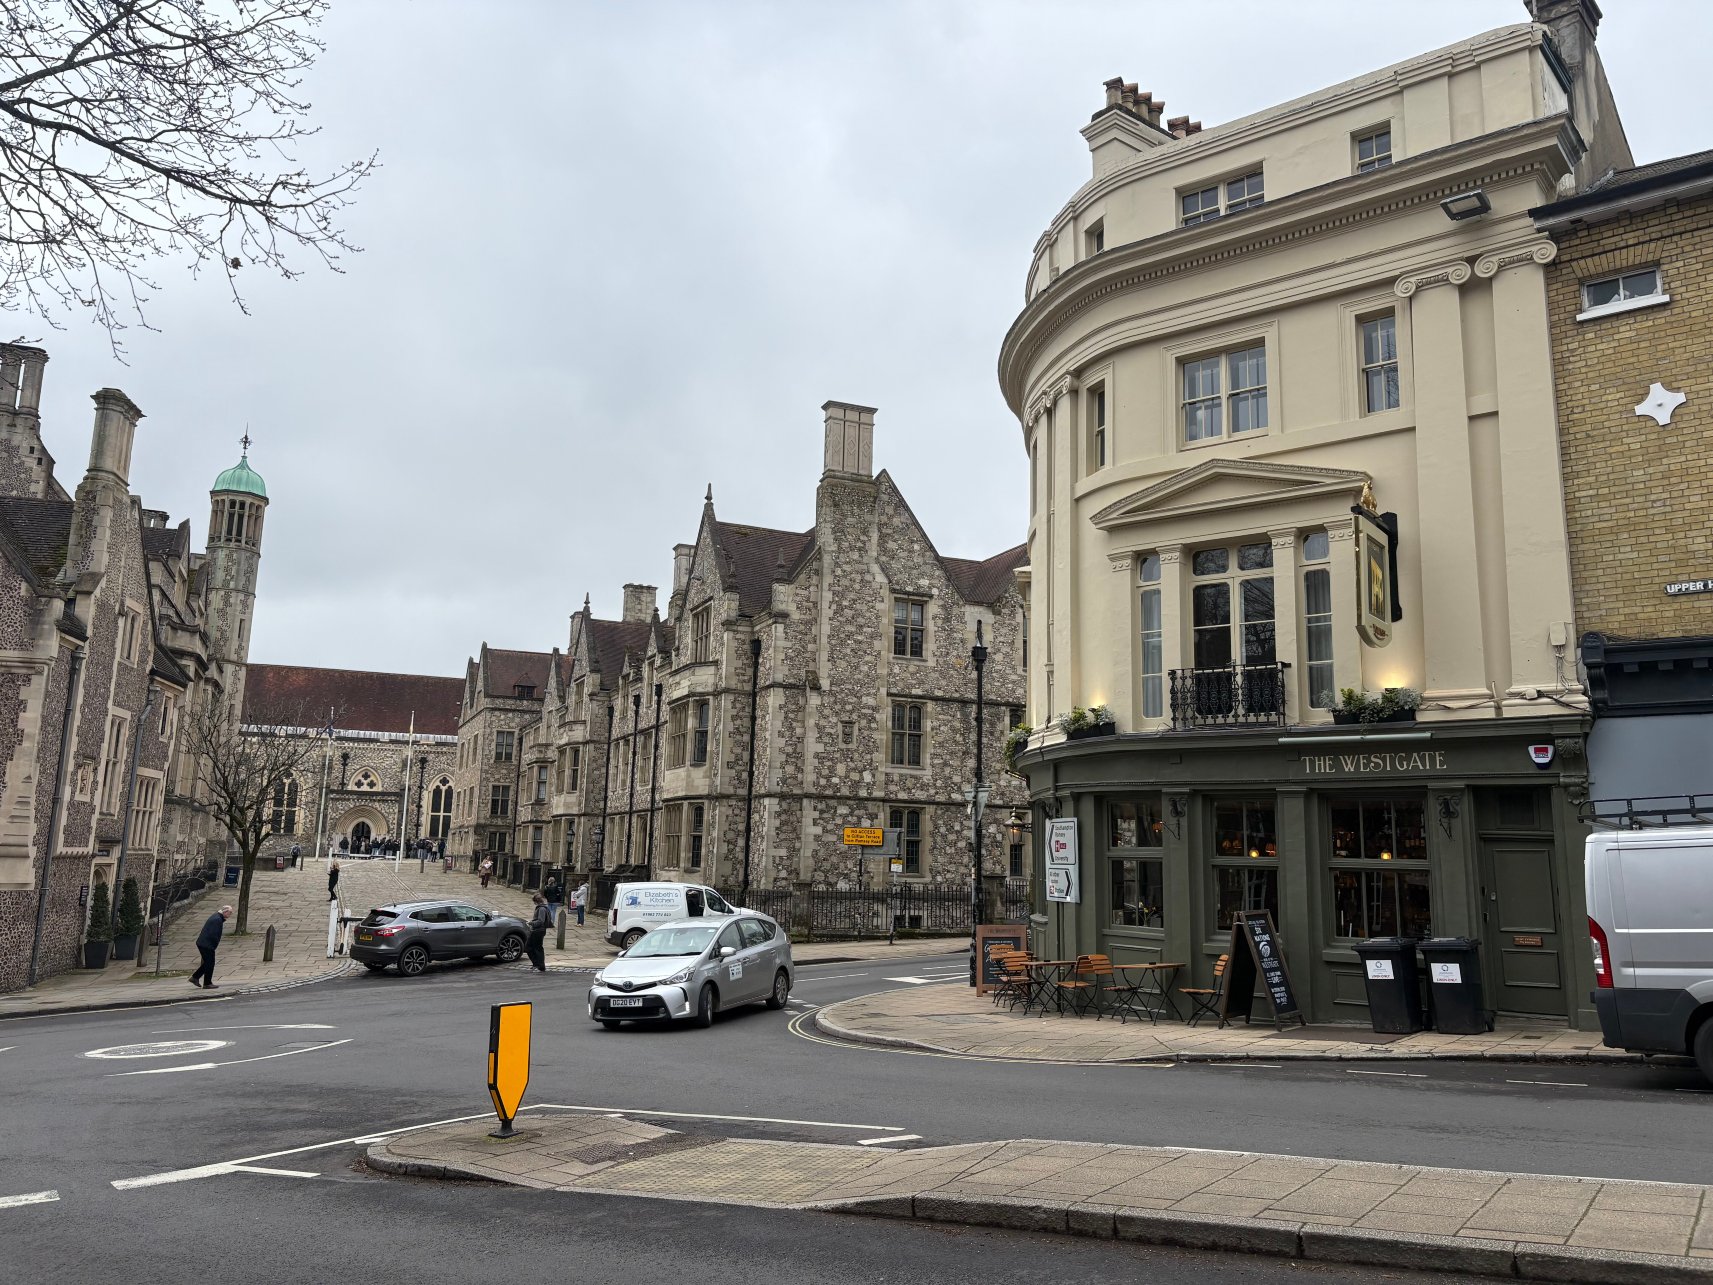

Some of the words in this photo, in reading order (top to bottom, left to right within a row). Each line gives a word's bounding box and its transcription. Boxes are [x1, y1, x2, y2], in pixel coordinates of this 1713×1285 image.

[1666, 581, 1704, 593] UPPER
[1301, 756, 1336, 773] THE
[1339, 751, 1447, 772] WESTGATE
